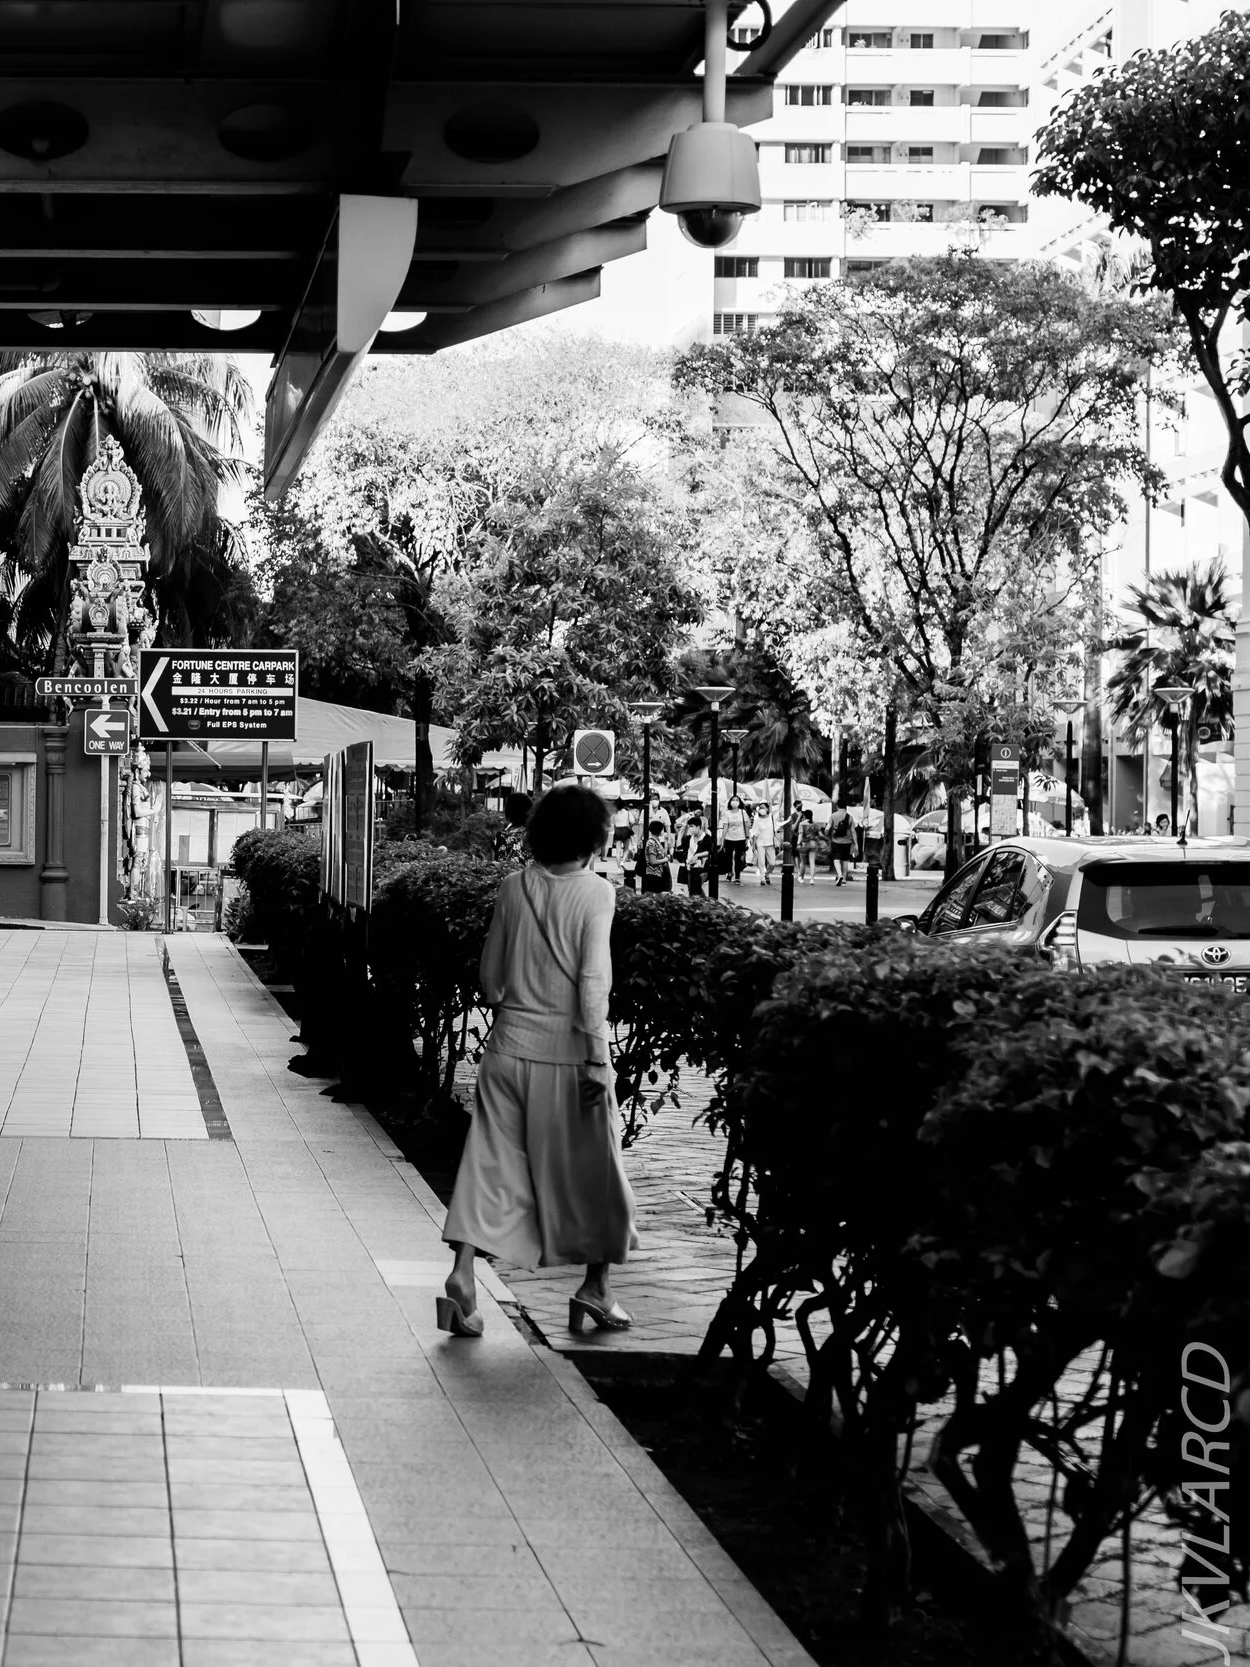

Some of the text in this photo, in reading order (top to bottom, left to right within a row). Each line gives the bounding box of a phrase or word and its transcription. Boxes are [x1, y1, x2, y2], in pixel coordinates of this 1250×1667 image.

[172, 660, 295, 671] FORTUNE CENTRE CARPARK
[172, 672, 294, 685] 金隆大厦停车场
[44, 680, 128, 694] Bencoolen
[199, 708, 221, 717] Entry
[222, 708, 241, 716] from
[250, 709, 262, 717] pm
[88, 740, 125, 751] ONE WAY
